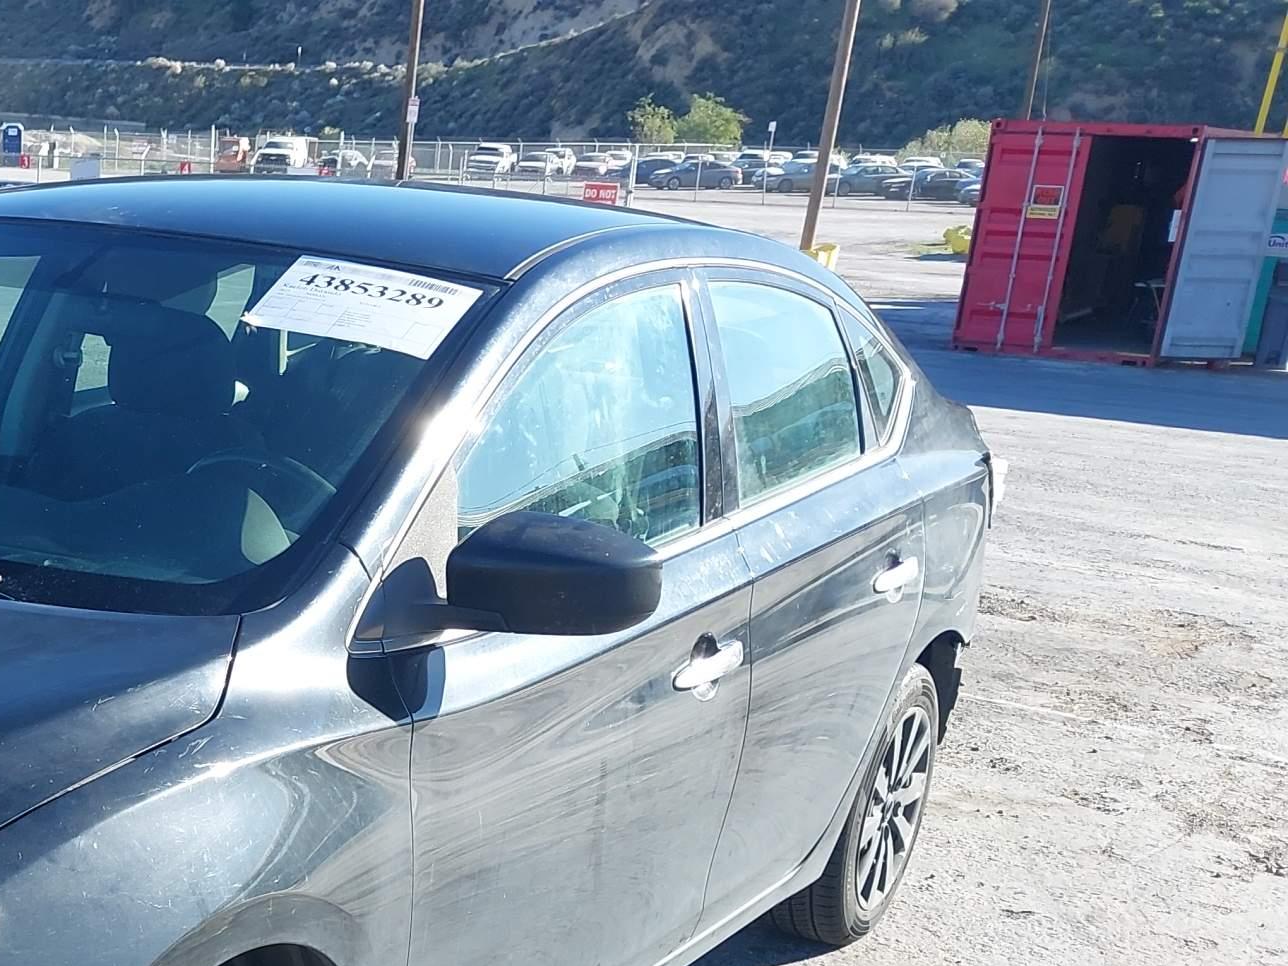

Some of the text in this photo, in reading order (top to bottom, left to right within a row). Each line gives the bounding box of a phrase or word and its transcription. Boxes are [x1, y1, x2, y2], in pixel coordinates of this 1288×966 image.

[22, 156, 29, 169] 3
[585, 188, 617, 200] DO NOT
[298, 273, 445, 309] 43853289
